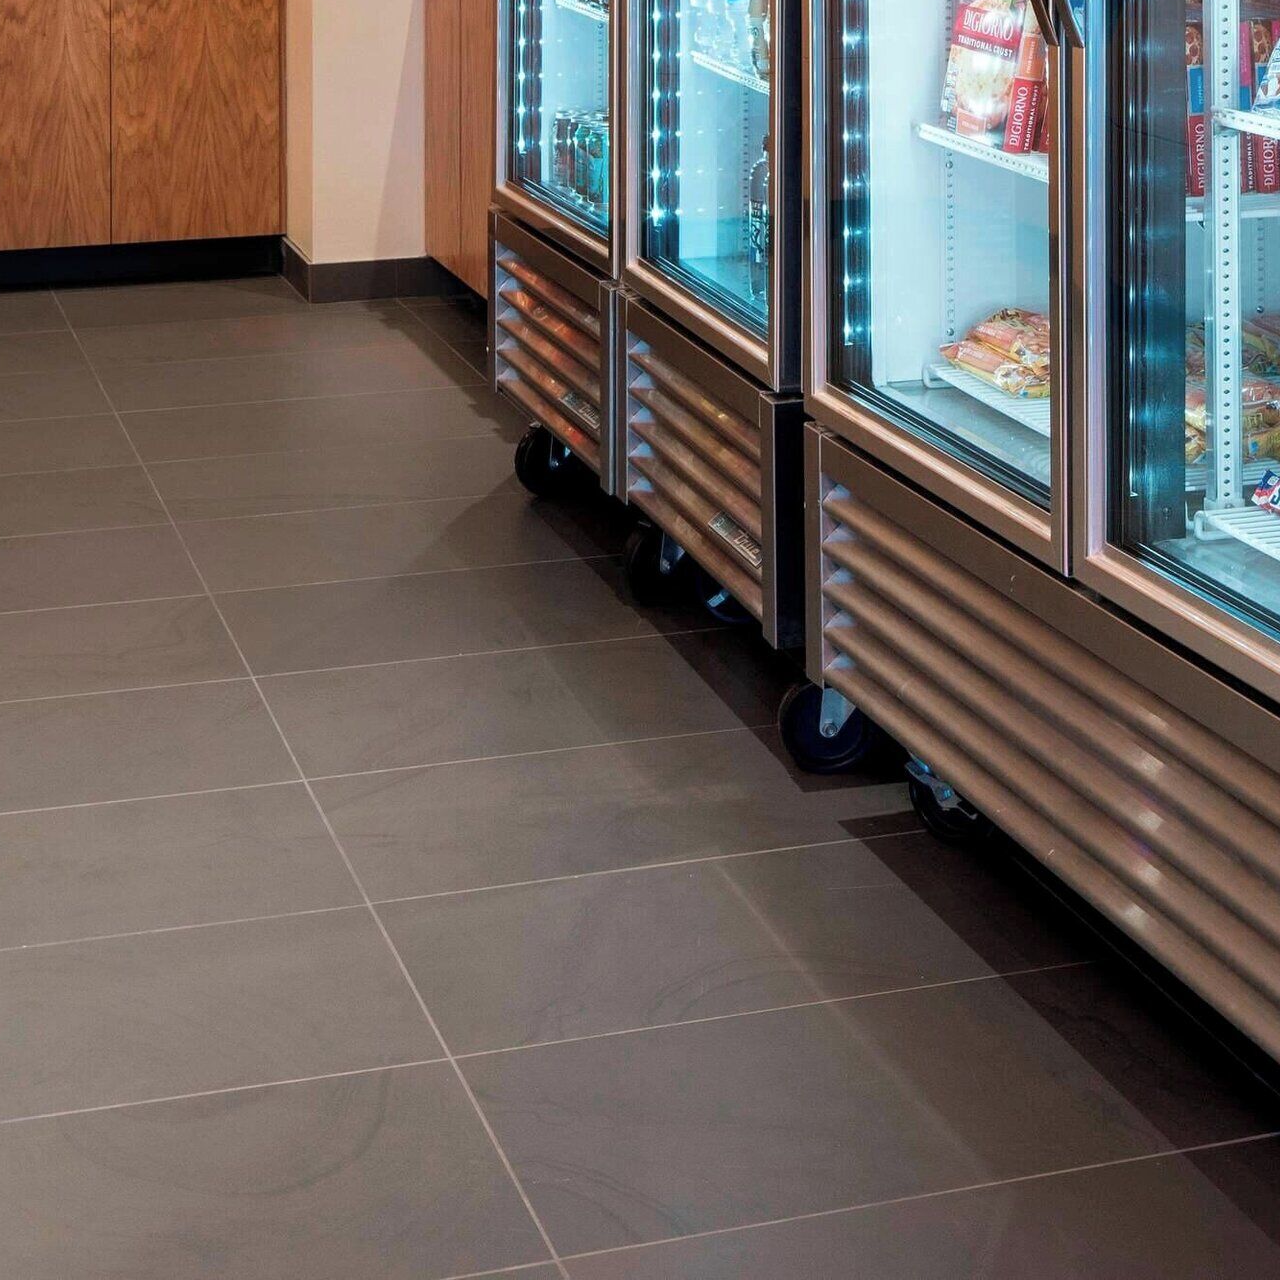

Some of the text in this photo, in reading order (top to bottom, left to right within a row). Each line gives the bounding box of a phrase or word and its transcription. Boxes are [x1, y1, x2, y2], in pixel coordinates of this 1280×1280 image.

[958, 34, 1013, 58] TRADITIONAL CRUST
[963, 8, 1014, 42] DIGIORNO
[1009, 86, 1029, 147] DIGIORNO
[1023, 107, 1036, 151] TRADITIONAL
[1263, 136, 1275, 187] DIGIOR
